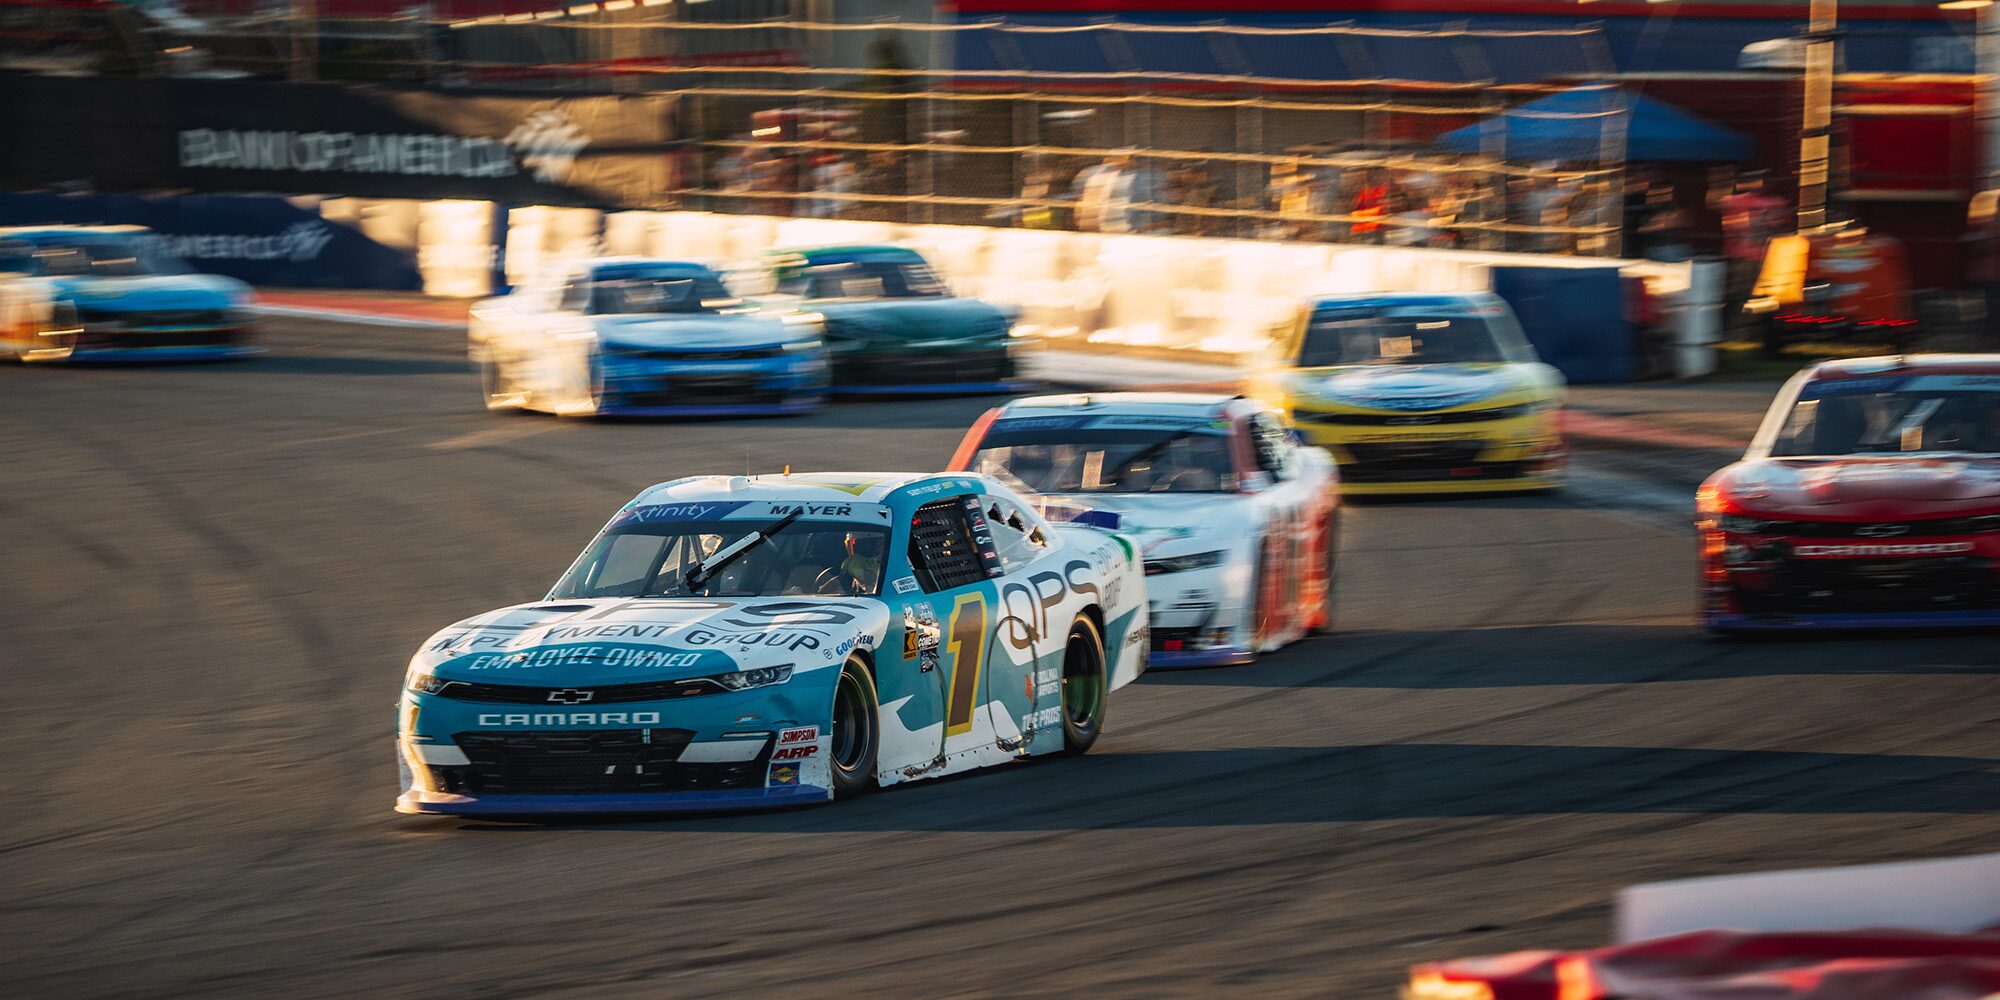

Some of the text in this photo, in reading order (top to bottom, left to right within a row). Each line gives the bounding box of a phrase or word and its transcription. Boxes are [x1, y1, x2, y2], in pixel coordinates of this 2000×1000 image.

[769, 505, 852, 516] MAYER
[1003, 559, 1100, 650] QPS
[425, 623, 820, 652] MPLOYMENT GROUP
[468, 646, 703, 670] EMPLOYEE OWNED
[946, 591, 987, 737] 1
[478, 712, 660, 726] CAMARO
[781, 728, 816, 743] SIMPSON
[772, 745, 819, 759] ARP
